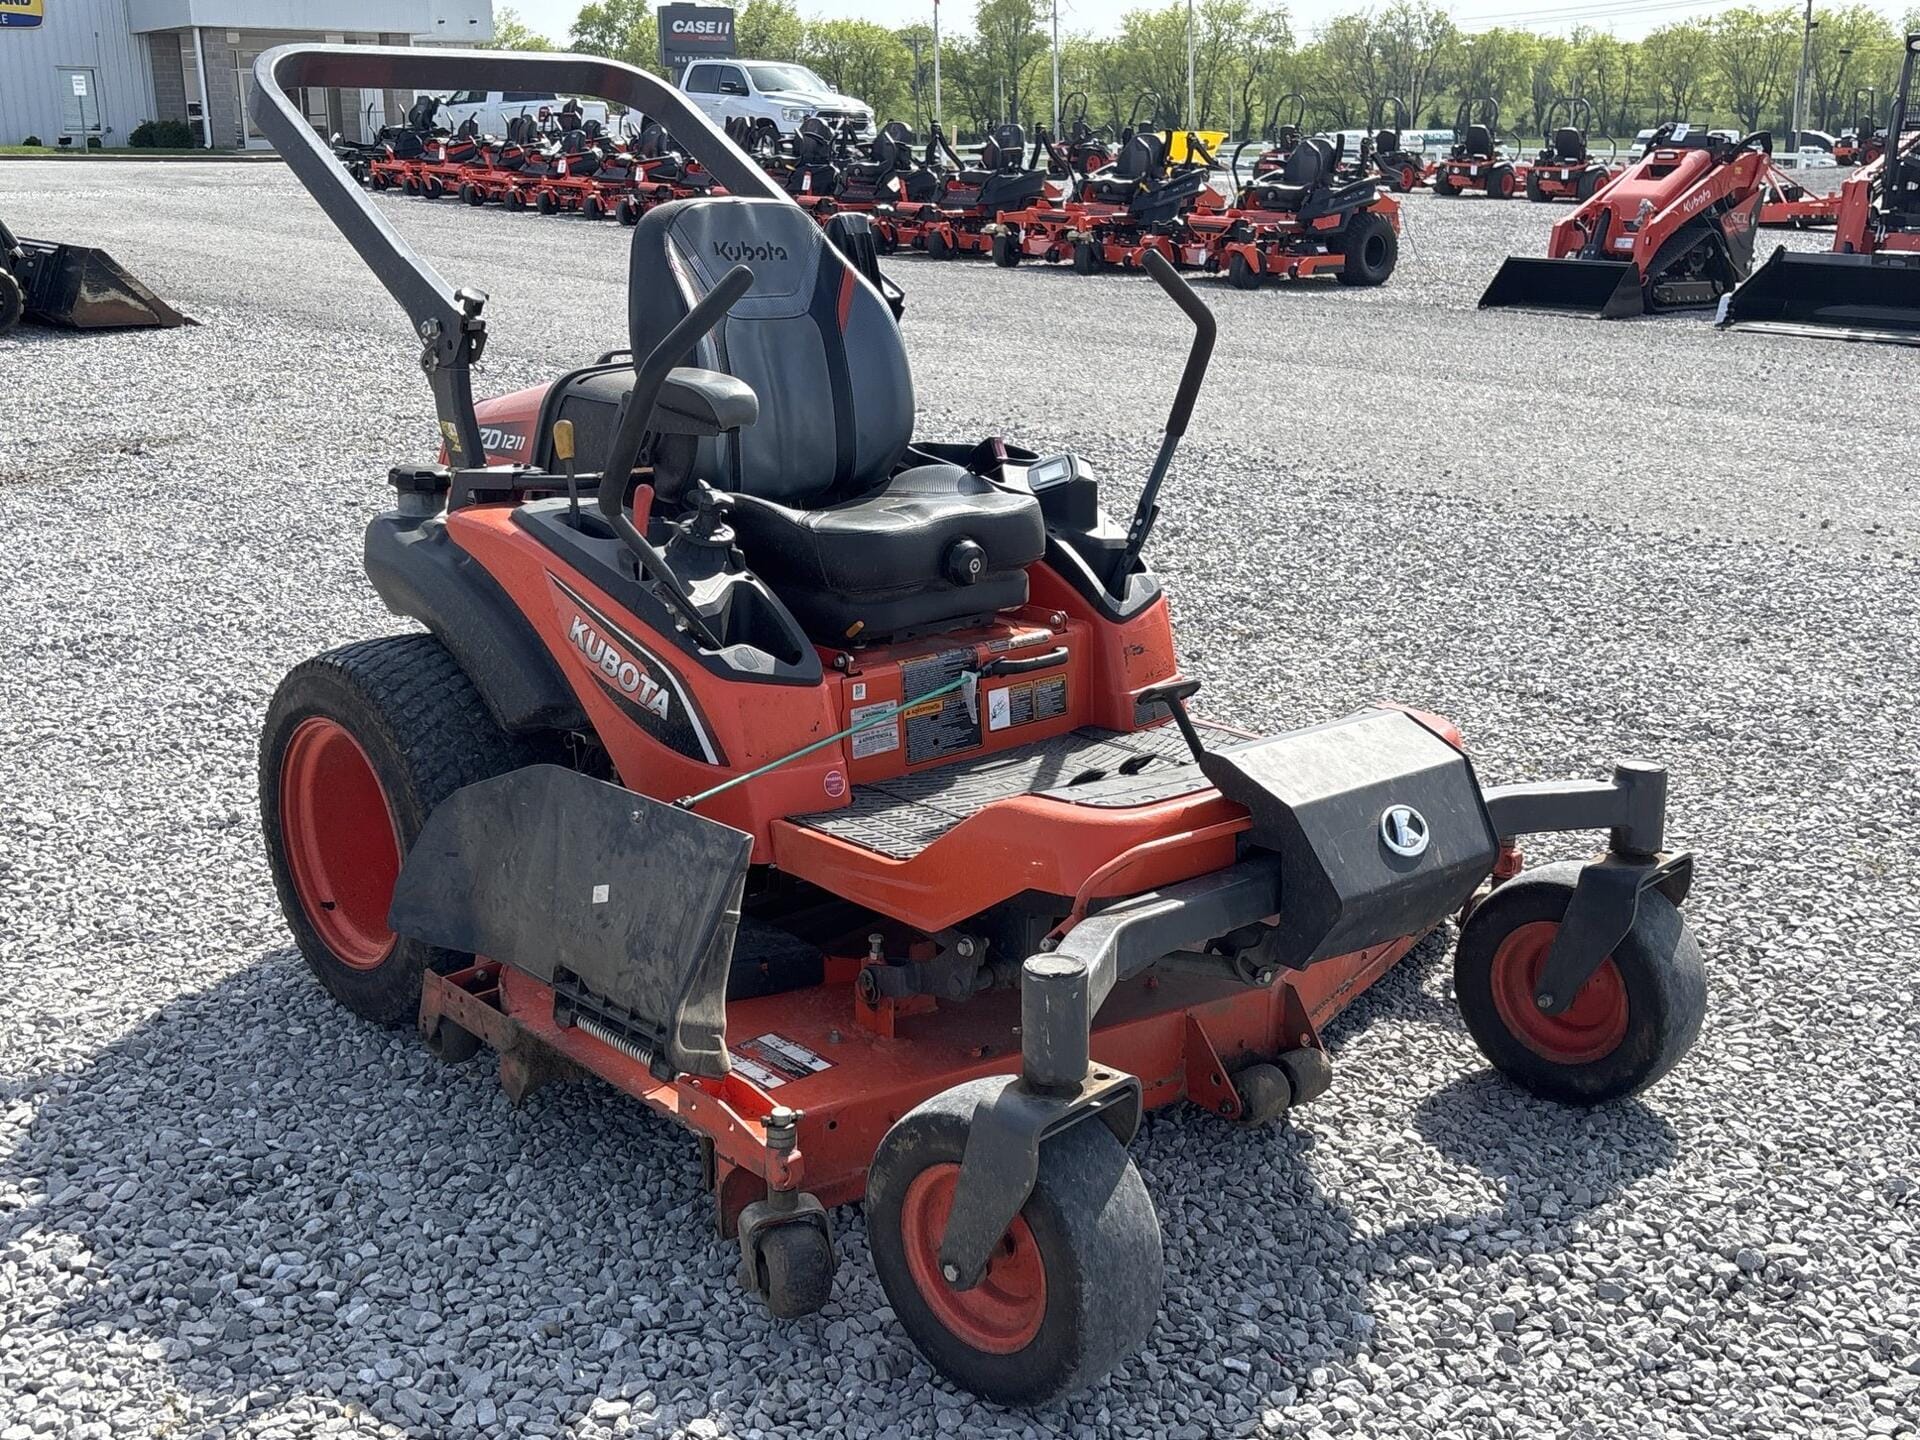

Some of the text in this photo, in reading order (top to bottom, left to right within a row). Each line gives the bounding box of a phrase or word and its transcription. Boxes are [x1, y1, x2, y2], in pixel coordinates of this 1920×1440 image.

[672, 20, 716, 34] CASE
[1682, 189, 1711, 213] Kubota
[713, 241, 788, 262] Kubota
[479, 427, 502, 450] ZD
[501, 434, 526, 451] 1211
[568, 614, 670, 721] KUBOTA
